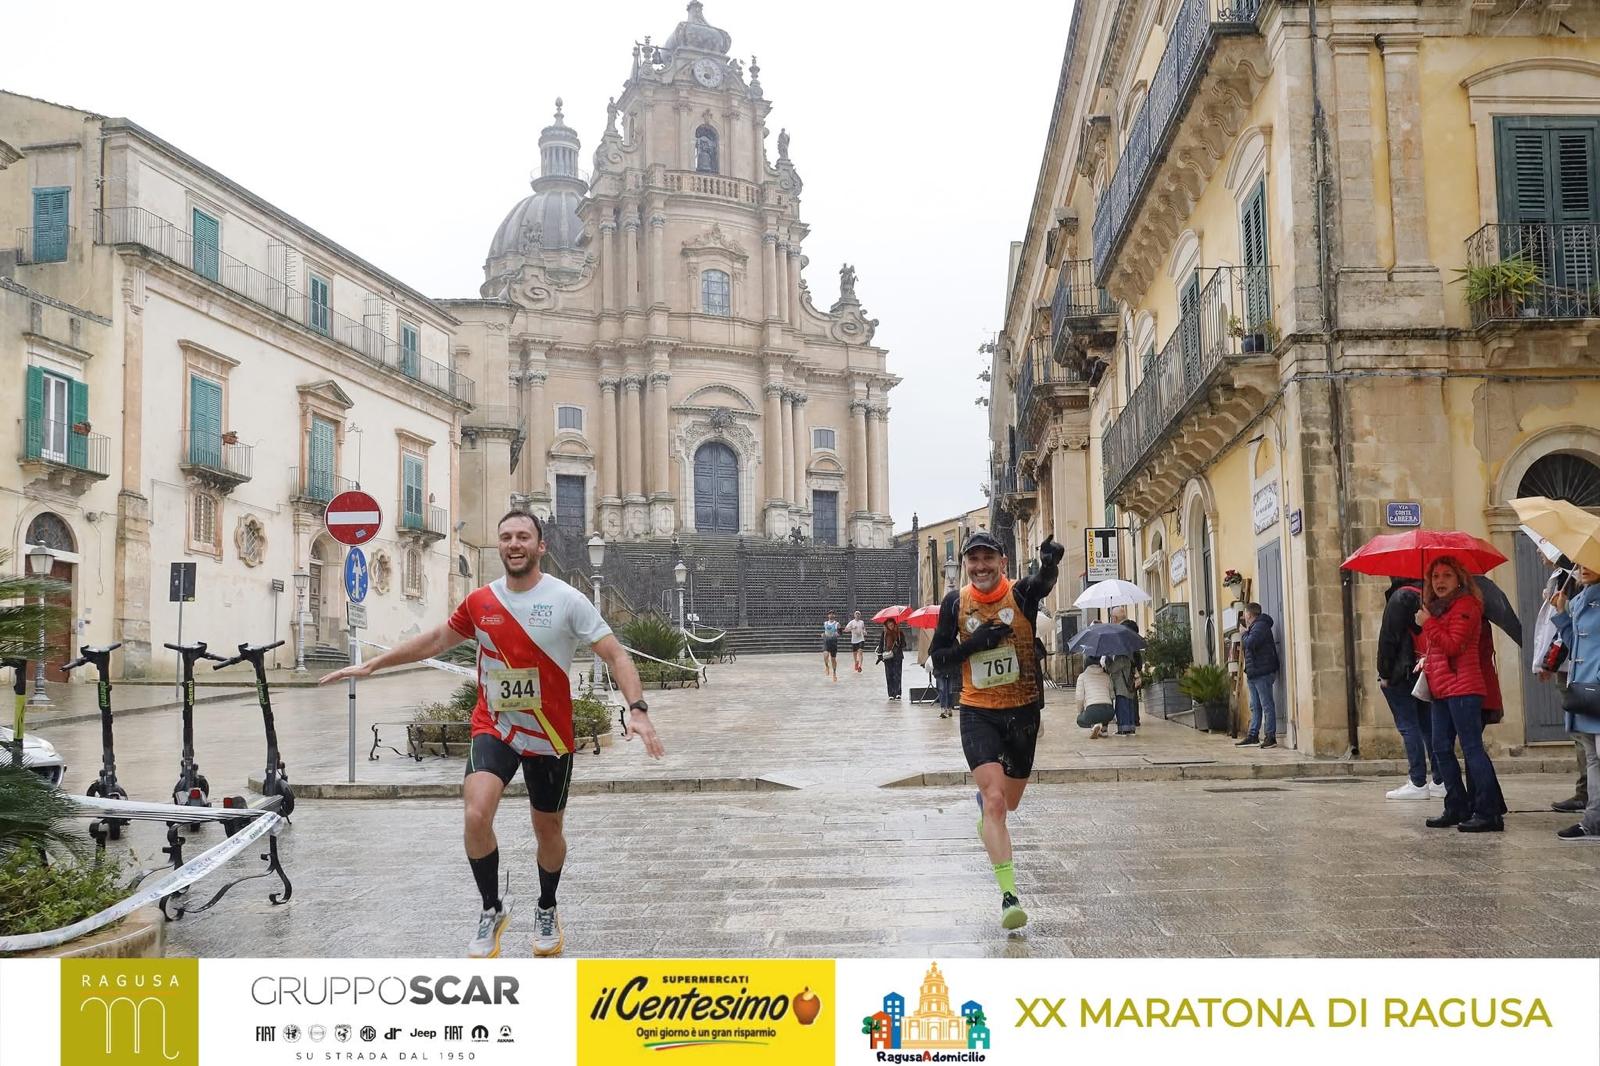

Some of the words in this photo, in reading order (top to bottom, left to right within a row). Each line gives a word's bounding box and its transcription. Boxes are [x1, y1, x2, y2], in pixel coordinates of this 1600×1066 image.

[1095, 530, 1116, 558] T
[983, 657, 1012, 677] 767
[500, 680, 535, 699] 344
